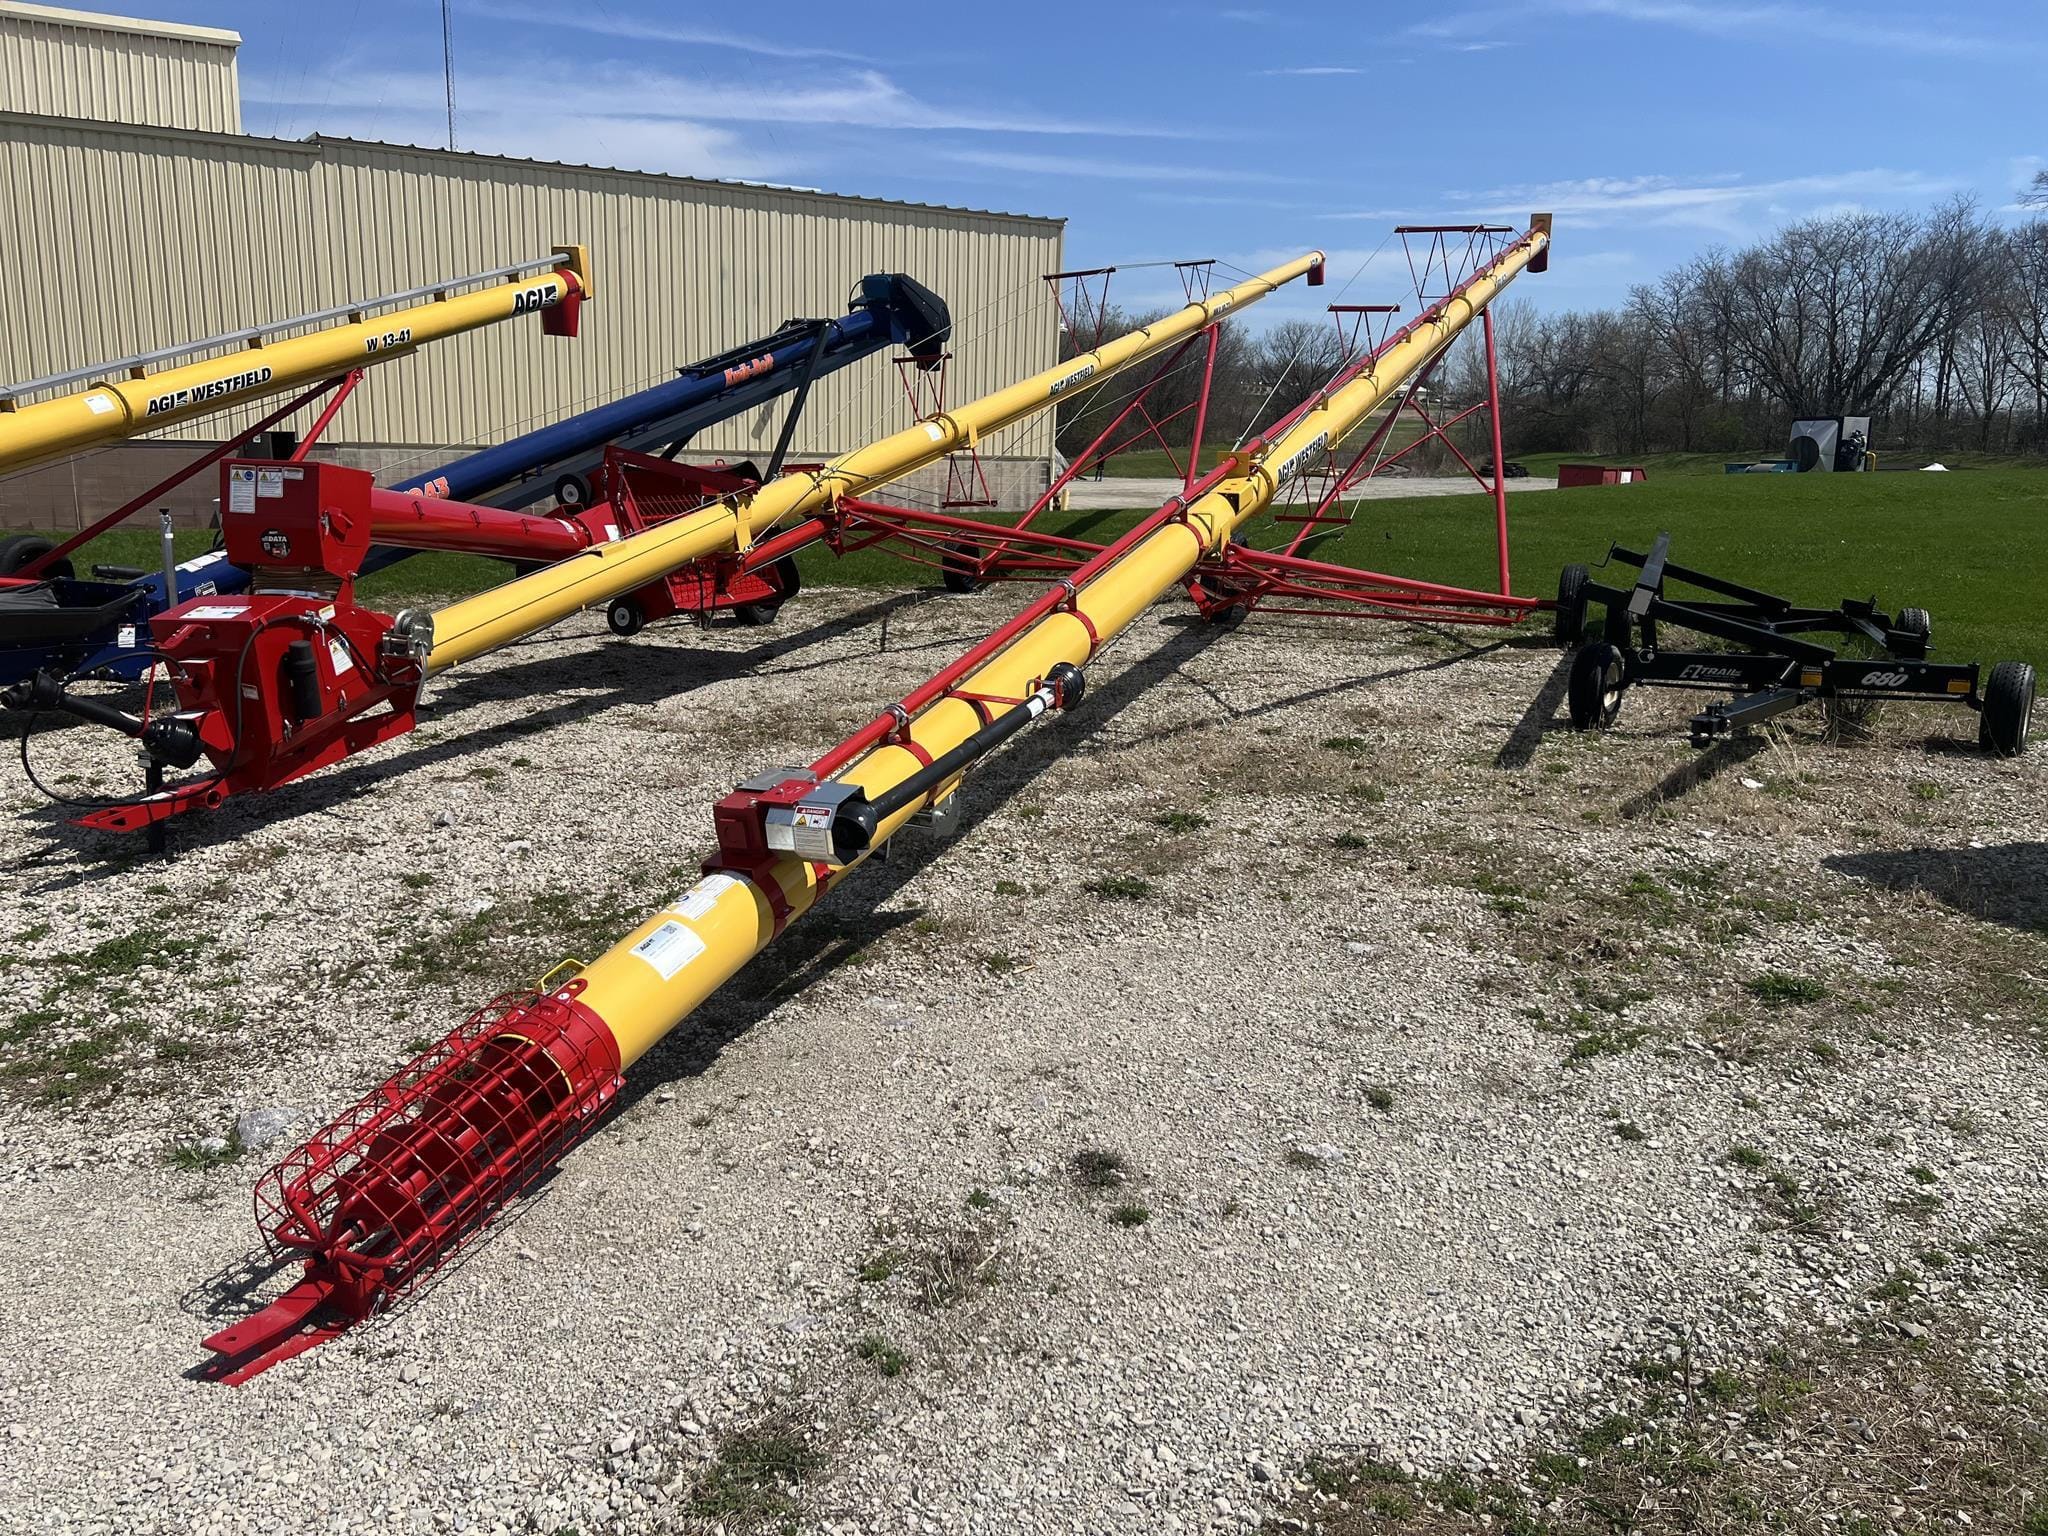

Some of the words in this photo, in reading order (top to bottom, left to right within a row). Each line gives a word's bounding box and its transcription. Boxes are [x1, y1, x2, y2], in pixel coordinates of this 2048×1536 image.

[512, 288, 543, 316] AGI
[366, 337, 378, 352] W
[382, 328, 411, 348] 13-41
[1065, 364, 1095, 388] WESTFIELD
[146, 393, 175, 416] AGI
[190, 367, 272, 403] WESTFIELD
[1277, 461, 1290, 486] AGI
[1294, 431, 1329, 468] WESTFIELD
[1861, 671, 1909, 687] 680
